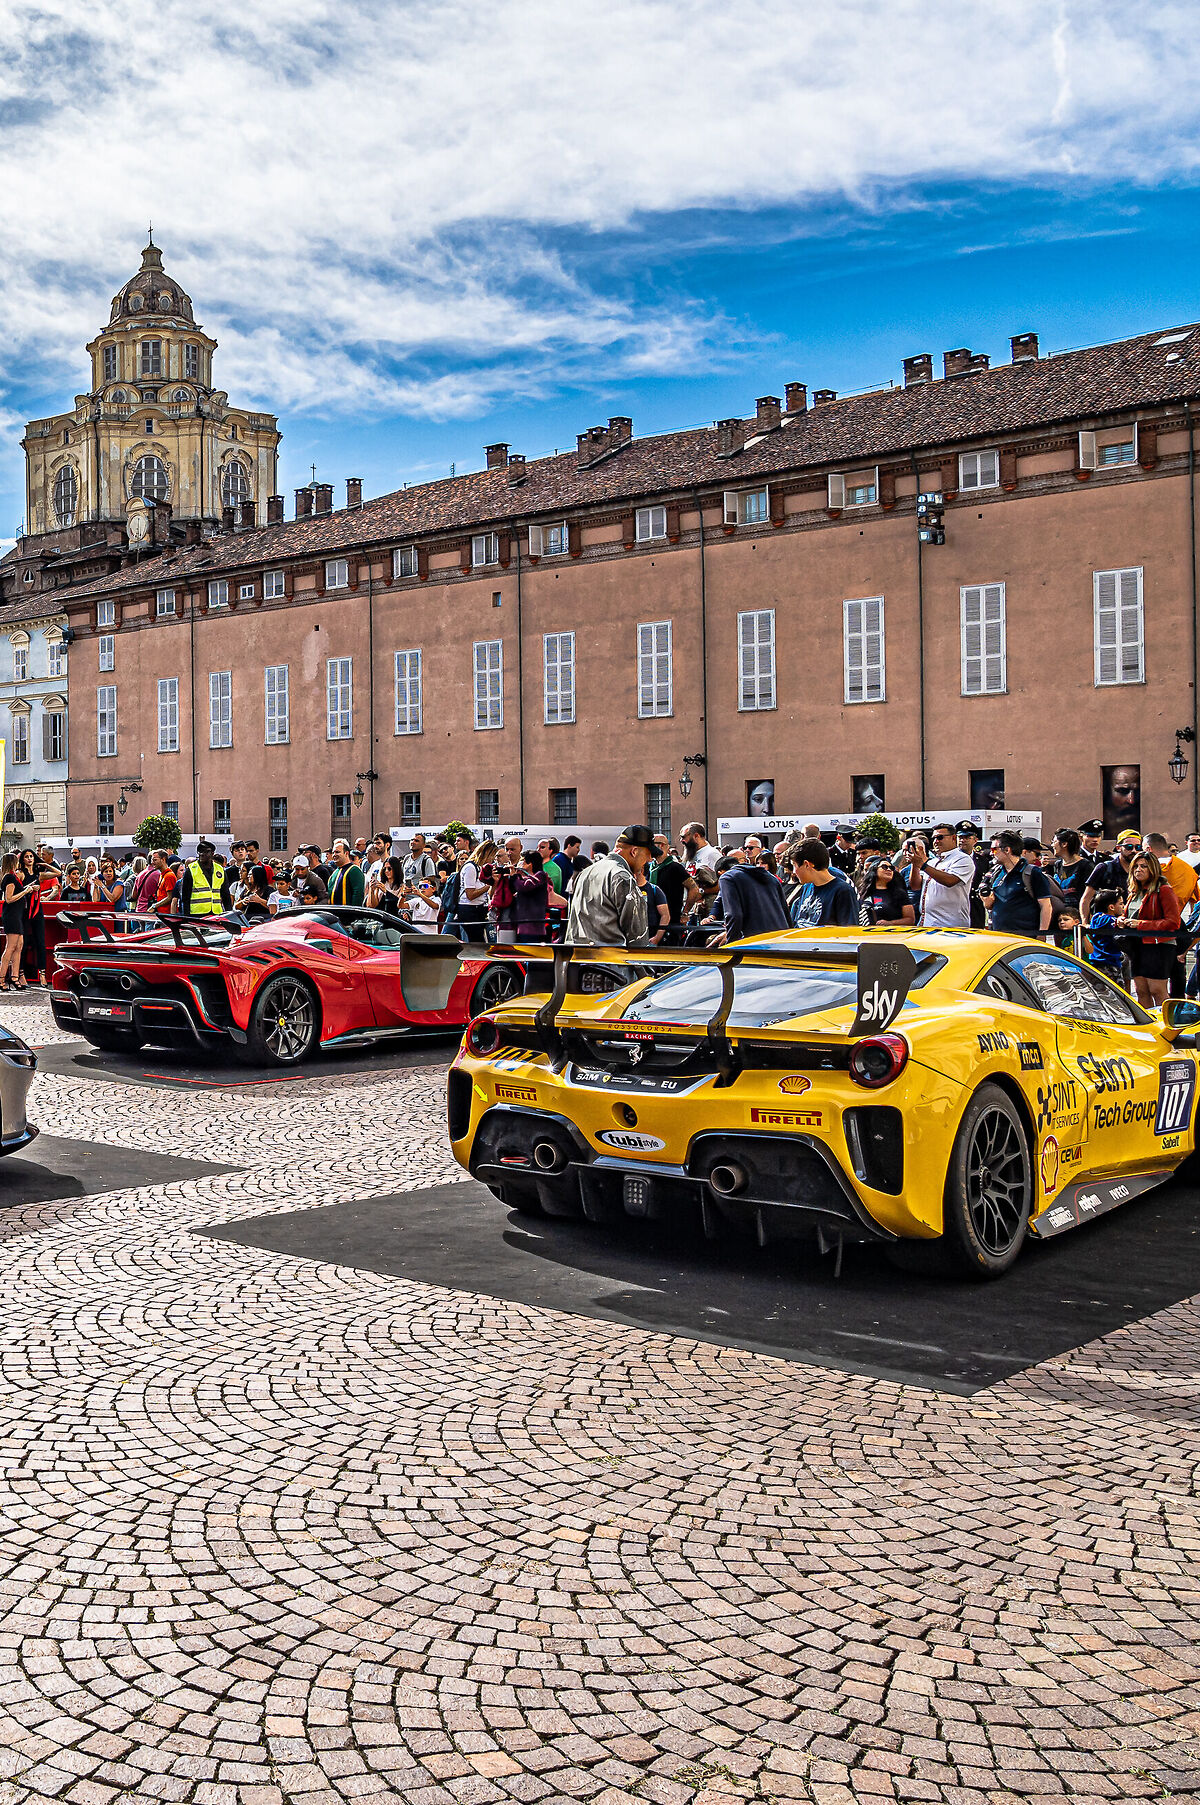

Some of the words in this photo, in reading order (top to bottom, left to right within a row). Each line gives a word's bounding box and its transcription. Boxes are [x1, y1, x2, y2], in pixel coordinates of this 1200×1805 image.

[763, 820, 795, 829] LOTUS
[895, 816, 931, 825] LOTUS
[1007, 815, 1021, 823] LOTUS
[859, 980, 898, 1029] sky
[607, 1024, 673, 1032] ROSSOCORSA
[976, 1031, 1010, 1054] AYNO
[575, 1073, 599, 1081] SAM
[660, 1080, 678, 1089] EU
[494, 1083, 538, 1102] PIRELLI
[1052, 1079, 1077, 1113] SINT
[1093, 1101, 1121, 1129] Tech
[1122, 1099, 1157, 1128] Group
[1157, 1083, 1191, 1131] 107
[750, 1107, 823, 1127] PIRELLI
[1108, 1184, 1130, 1201] IVECO
